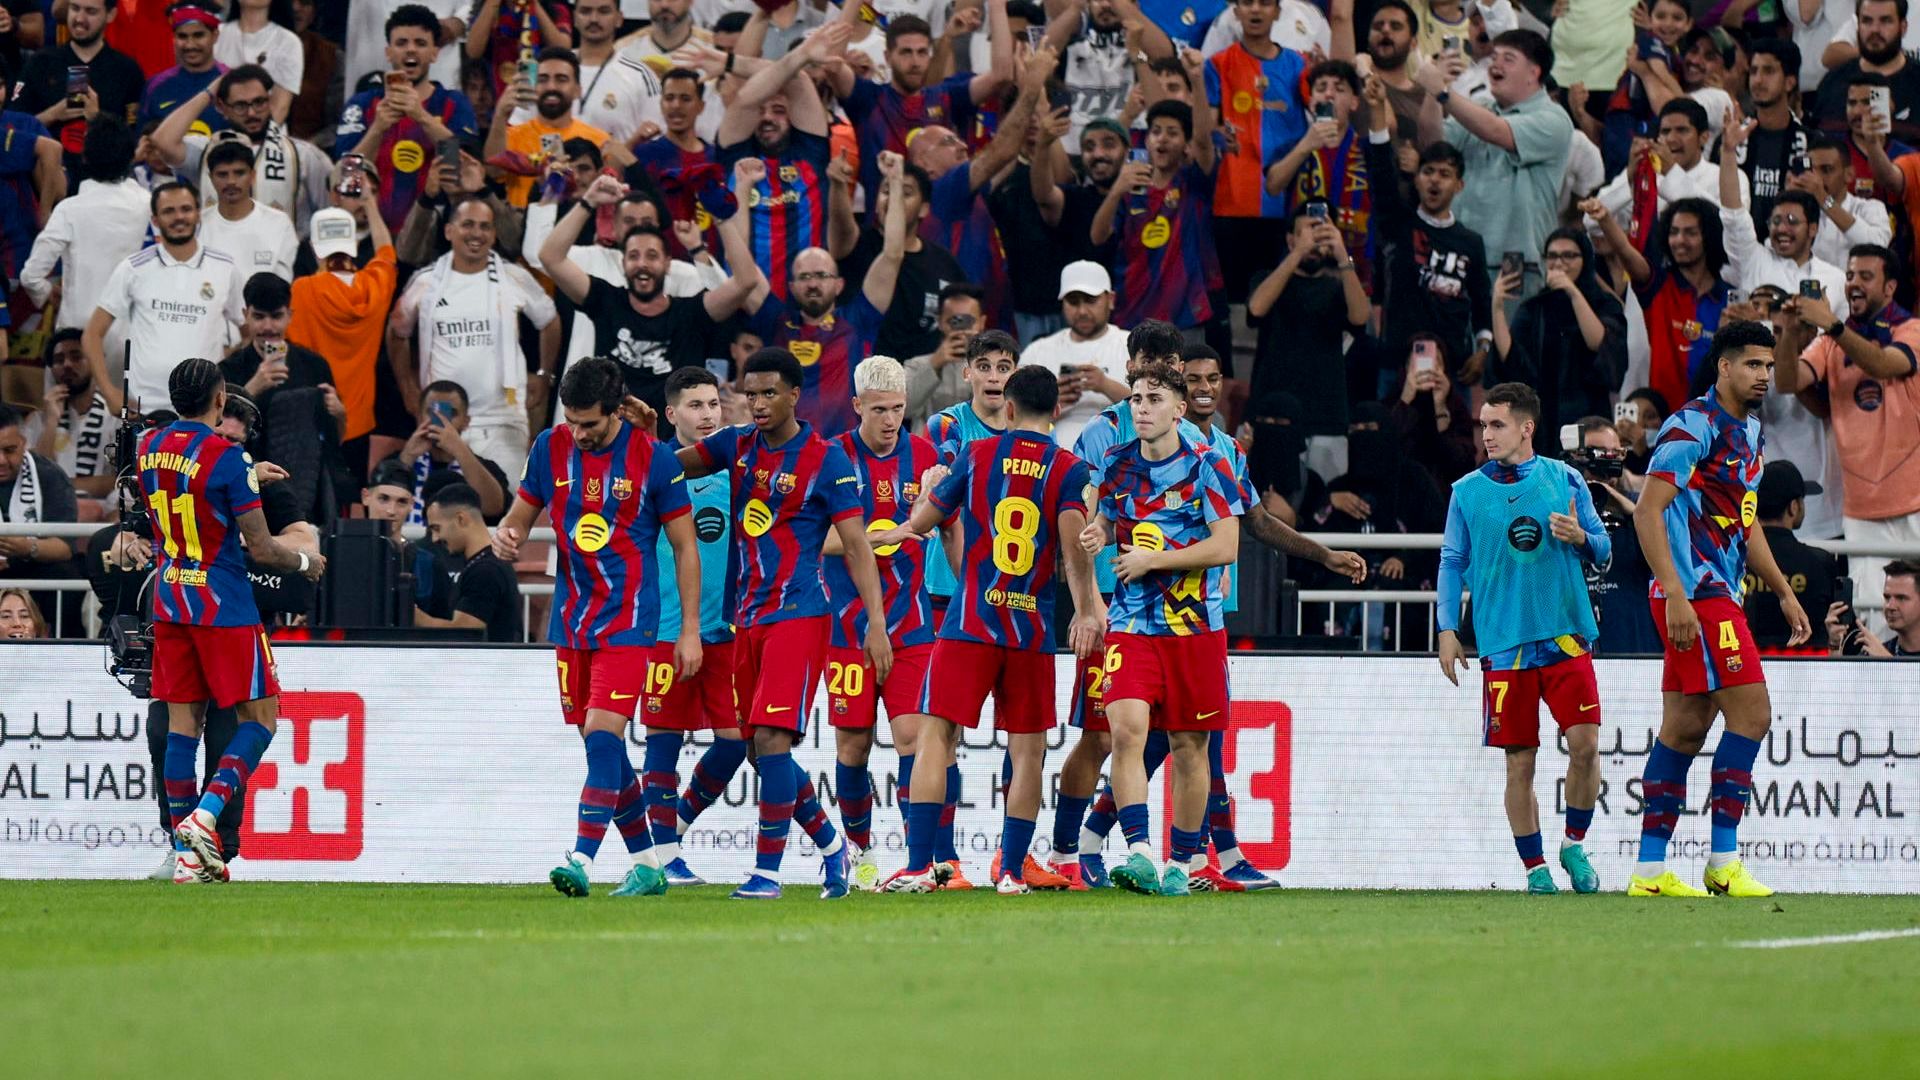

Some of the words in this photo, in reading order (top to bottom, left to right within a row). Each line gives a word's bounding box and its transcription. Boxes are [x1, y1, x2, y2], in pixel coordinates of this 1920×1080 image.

[151, 299, 207, 315] Emirates
[158, 312, 170, 321] FLY
[172, 314, 199, 324] BETTER
[436, 319, 491, 336] Emirat
[466, 335, 495, 347] BETTE
[139, 452, 201, 480] RAPHINHA
[1002, 458, 1047, 480] PEDRI
[148, 489, 203, 562] 11
[992, 496, 1041, 577] 8
[1006, 591, 1037, 603] UNHCR
[1006, 600, 1037, 611] ACNUR
[1718, 620, 1740, 651] 4
[1103, 644, 1122, 672] 6
[645, 662, 674, 695] 19
[828, 661, 863, 696] 20
[1087, 666, 1104, 698] 2
[1, 762, 49, 799] AL
[1855, 781, 1905, 818] AL
[691, 820, 759, 850] medi
